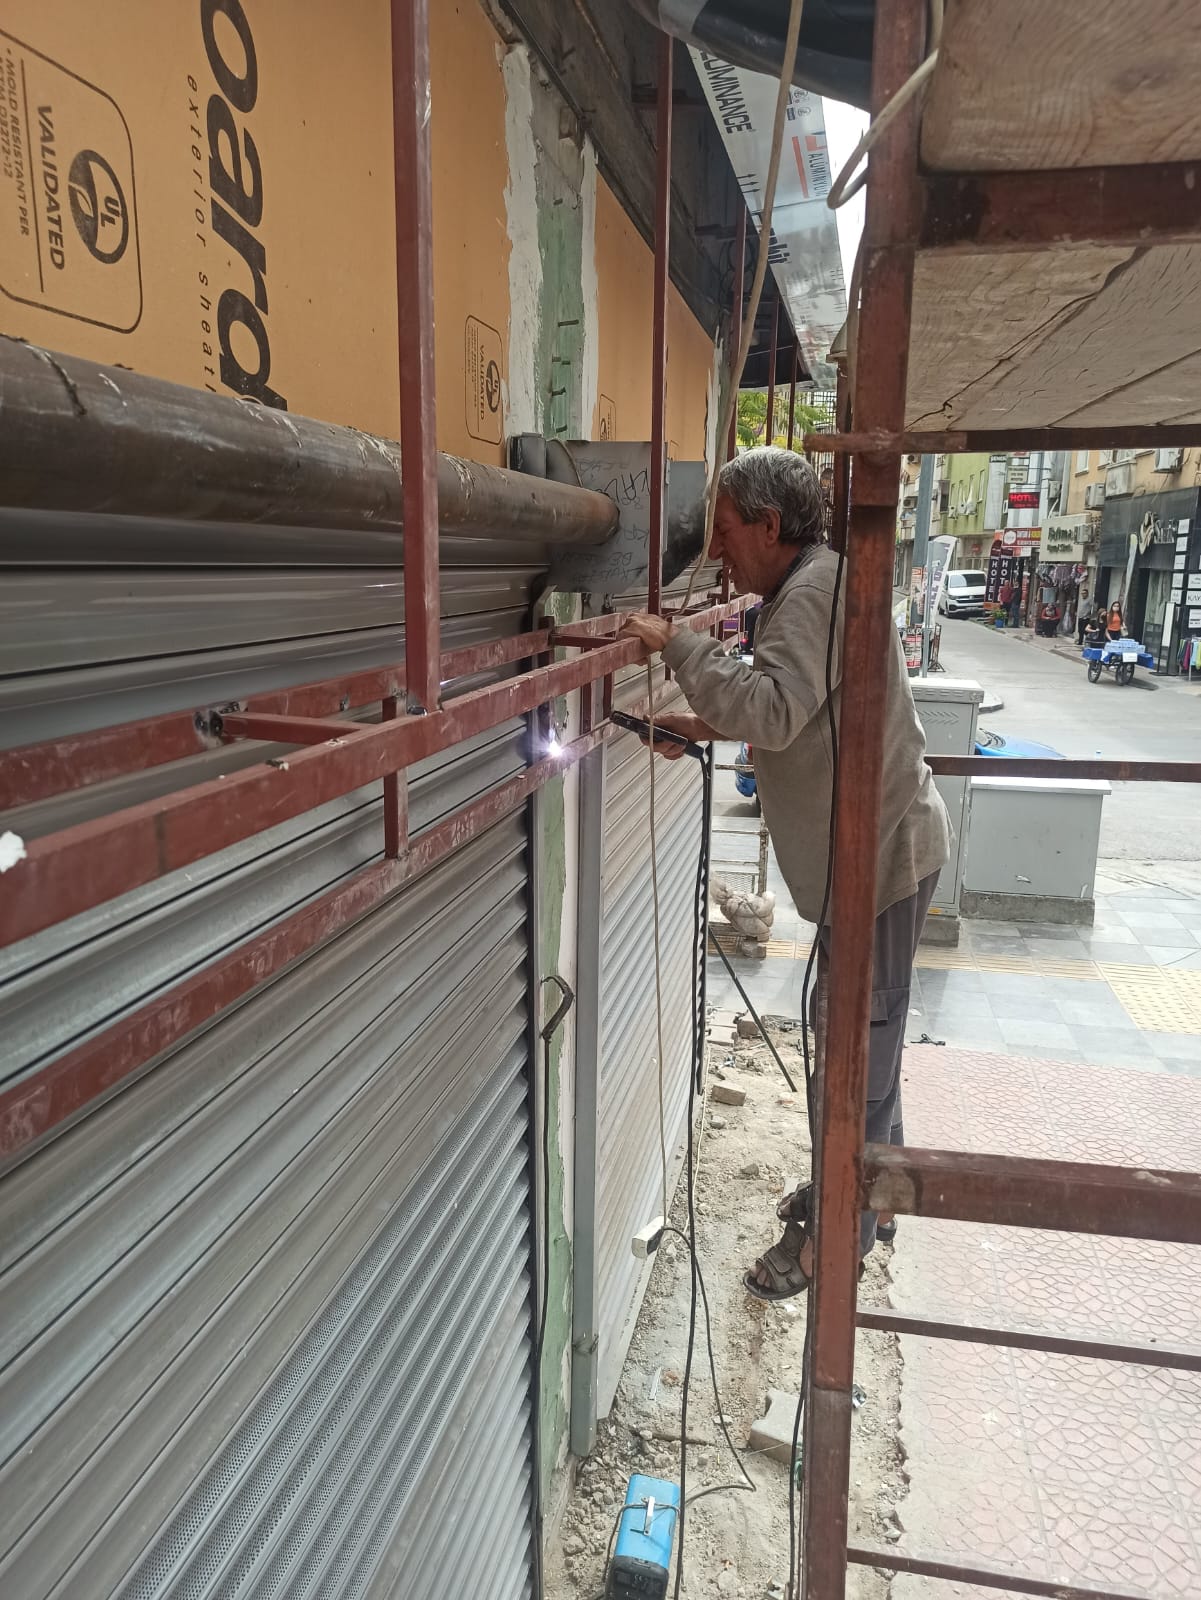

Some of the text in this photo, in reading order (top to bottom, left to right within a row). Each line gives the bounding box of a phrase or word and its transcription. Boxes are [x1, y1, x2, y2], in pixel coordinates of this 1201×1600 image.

[6, 58, 30, 236] MOLD RESISTANT PER
[37, 105, 65, 270] VALIDATED
[100, 194, 121, 228] UL
[187, 74, 207, 248] exterior
[988, 561, 998, 601] HOTEL
